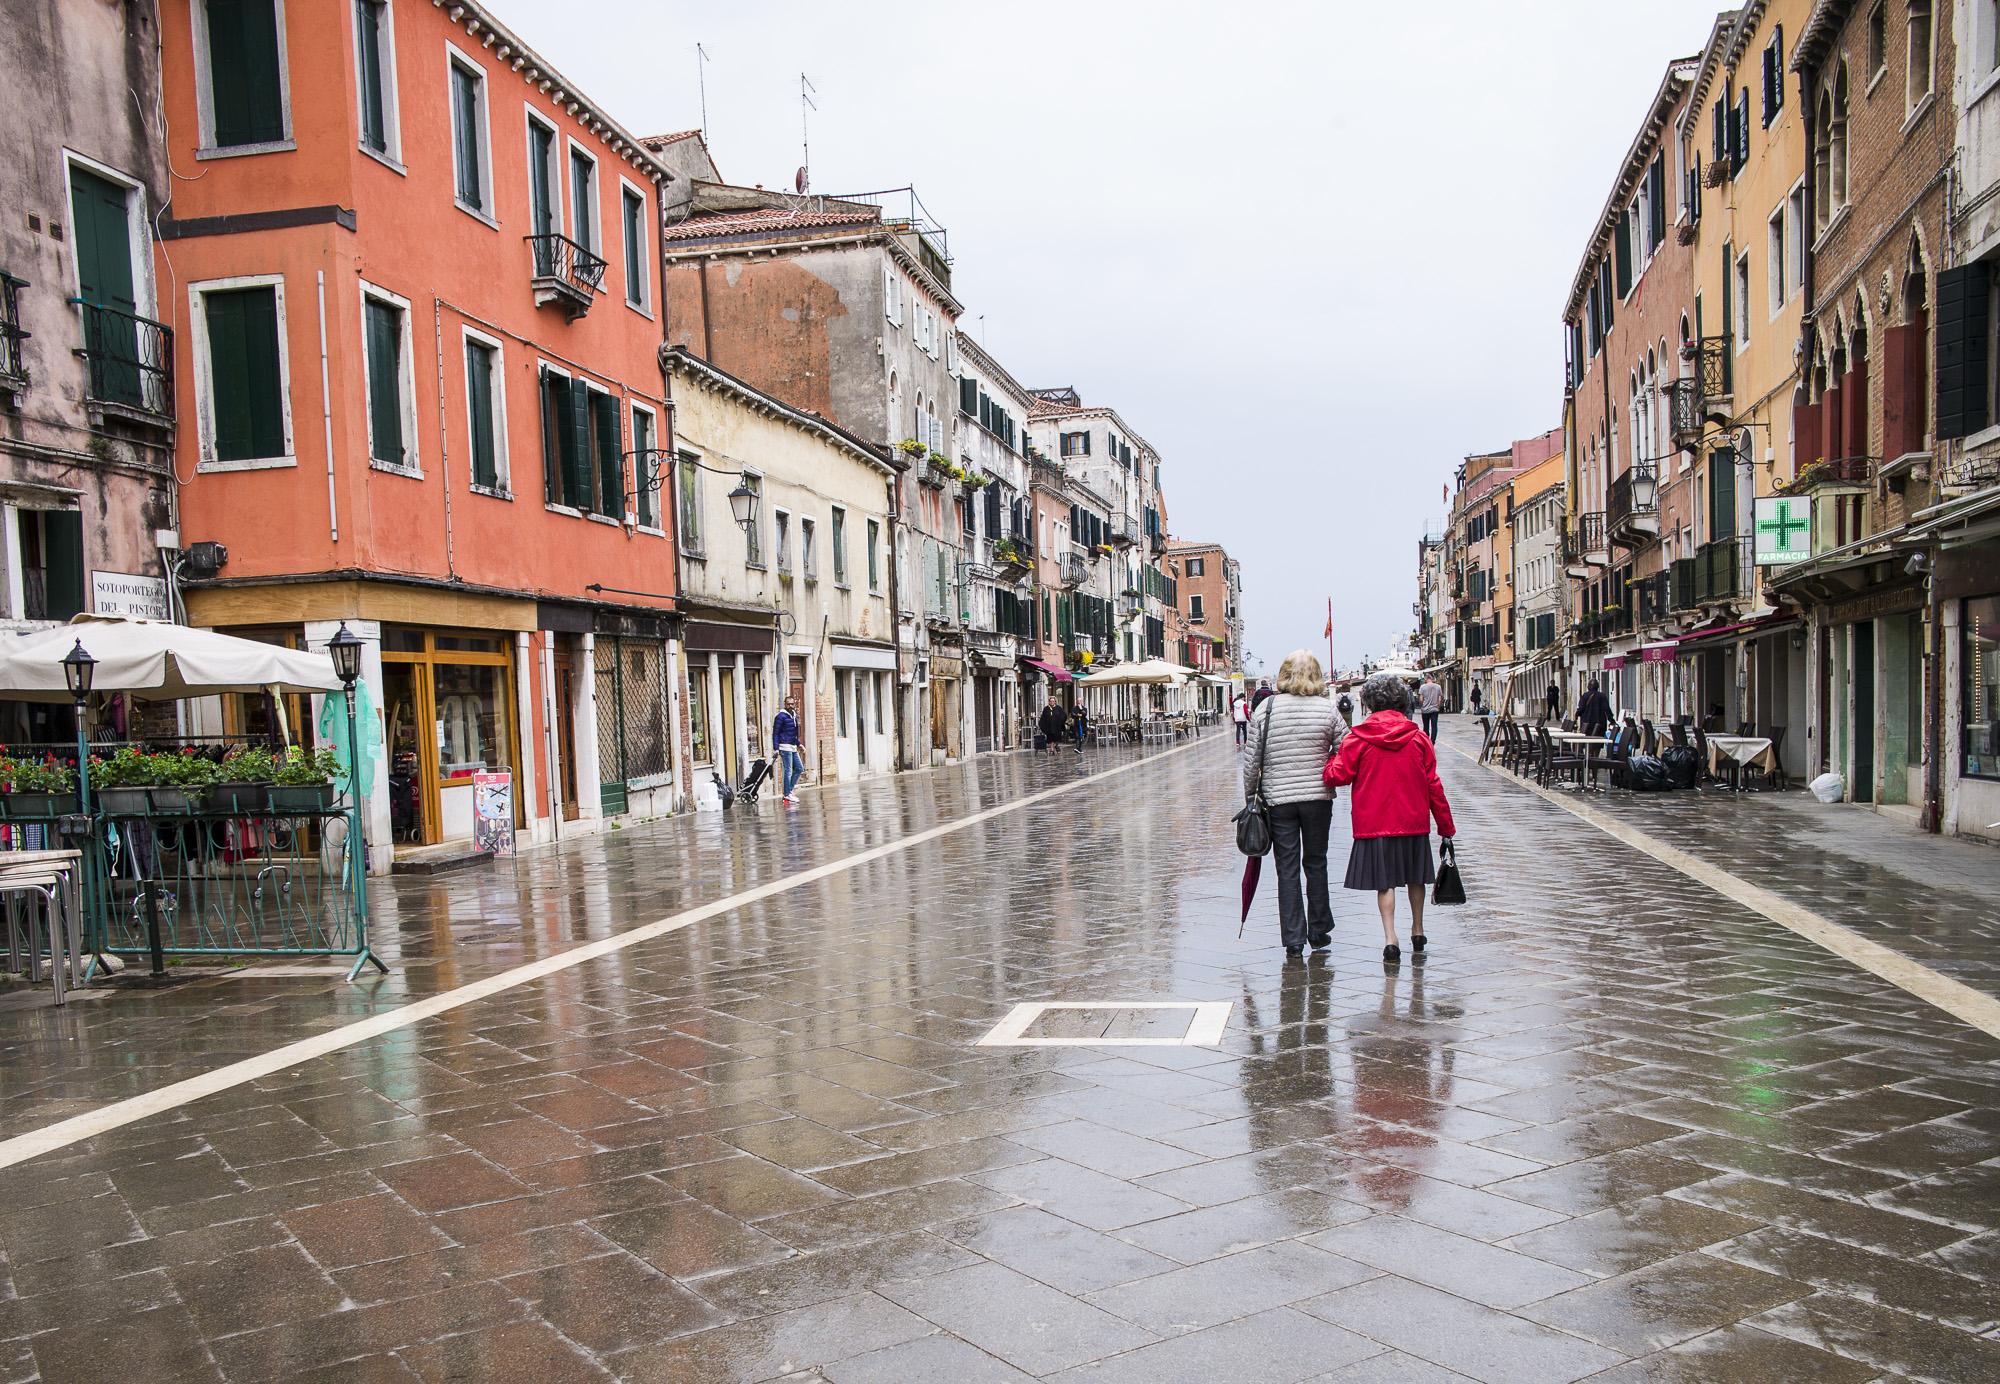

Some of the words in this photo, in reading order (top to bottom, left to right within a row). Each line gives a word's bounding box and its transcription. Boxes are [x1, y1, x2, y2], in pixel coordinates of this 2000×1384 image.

[1757, 551, 1808, 561] FARMACIA
[97, 582, 163, 597] SOTOPORTEGO
[101, 601, 120, 613] DEL
[129, 603, 162, 616] PISTOR
